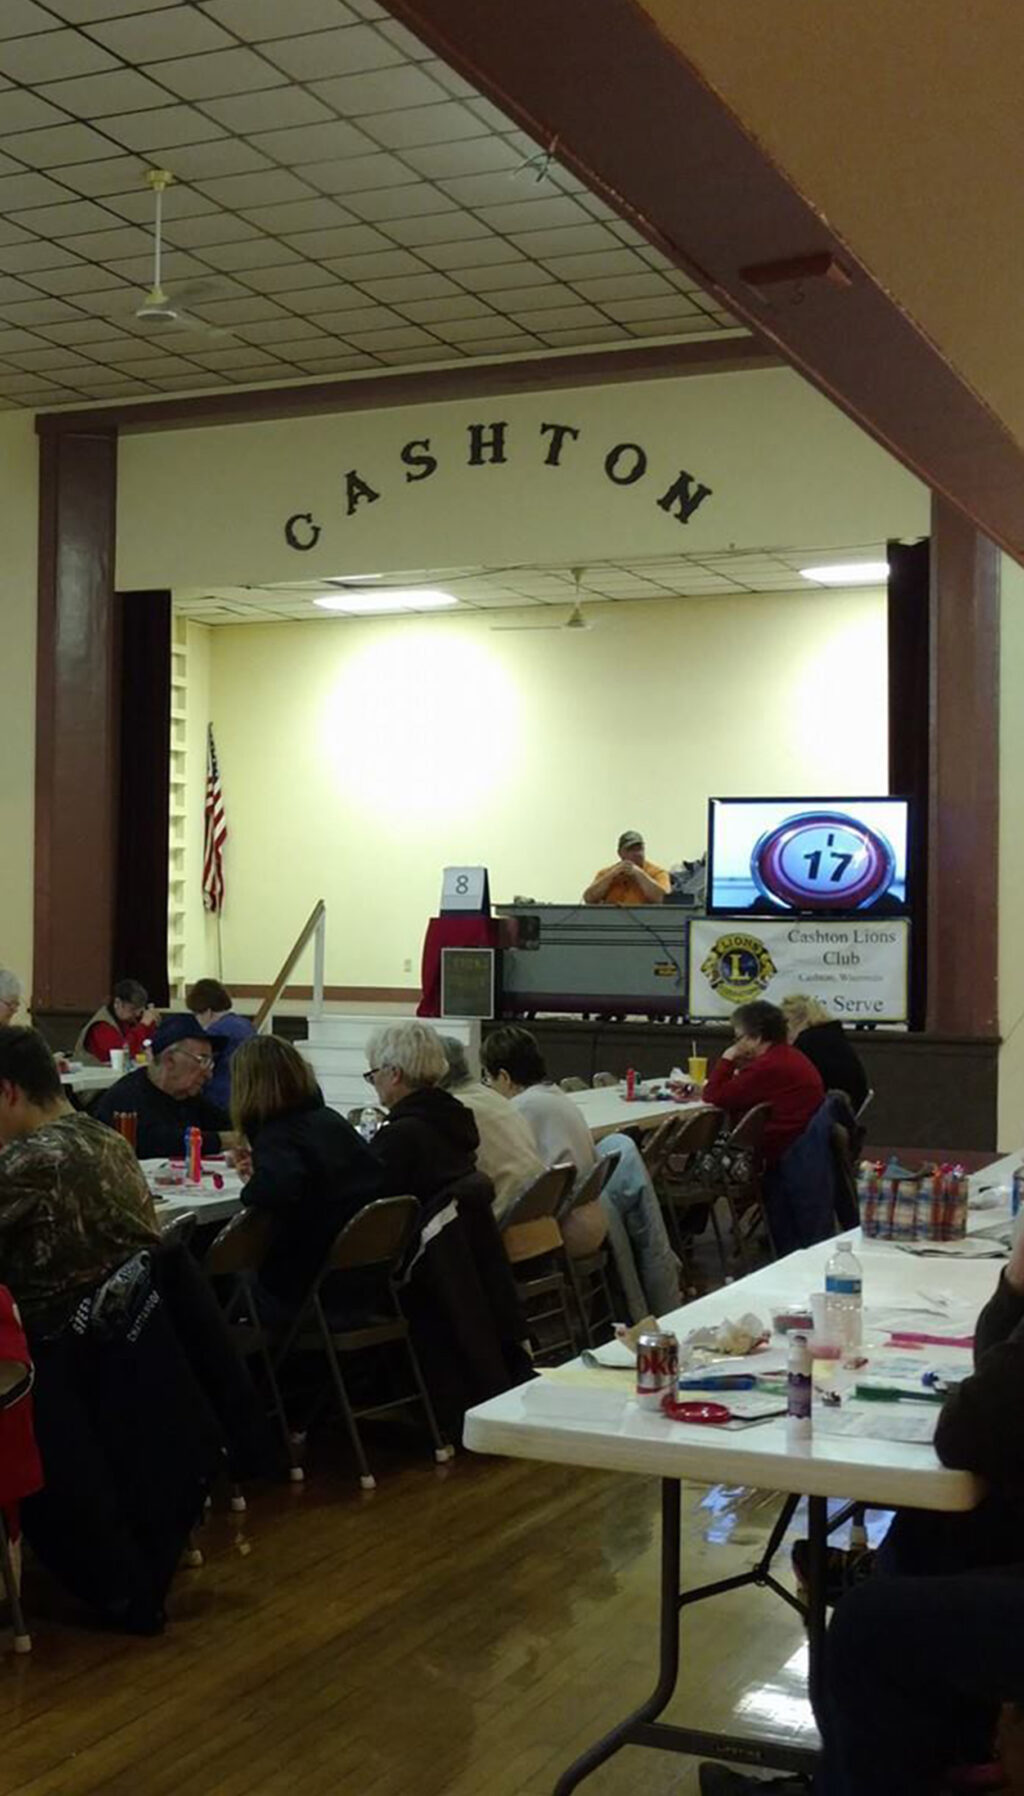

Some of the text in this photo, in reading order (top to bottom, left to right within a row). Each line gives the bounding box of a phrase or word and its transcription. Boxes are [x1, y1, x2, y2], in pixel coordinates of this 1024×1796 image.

[285, 422, 712, 551] CASHTON
[803, 850, 854, 882] 17
[455, 875, 469, 895] 8
[721, 936, 759, 950] LIONS
[788, 929, 896, 944] Cashton Lions
[728, 953, 752, 981] L
[822, 951, 860, 966] Club
[833, 995, 884, 1012] Serve
